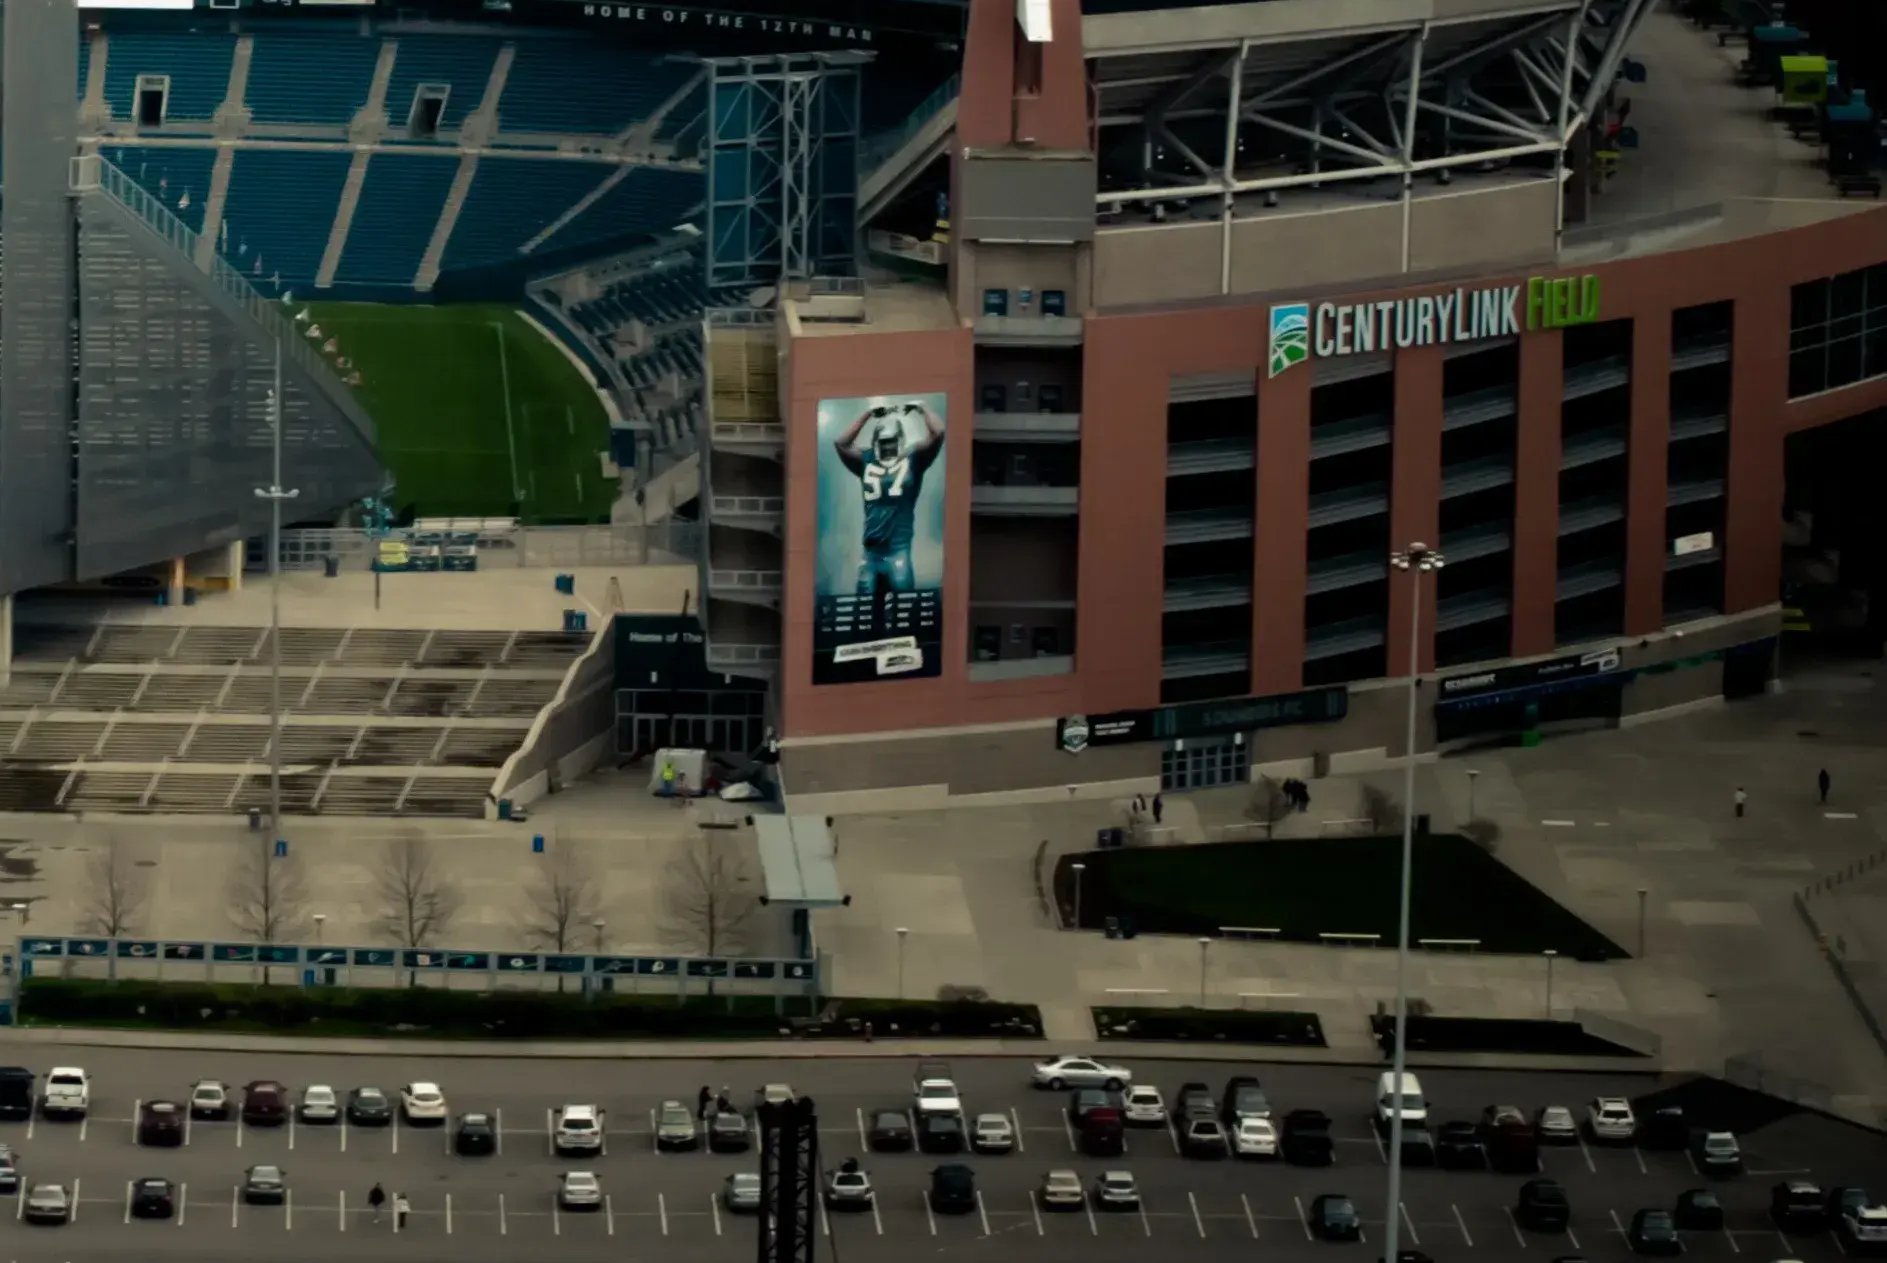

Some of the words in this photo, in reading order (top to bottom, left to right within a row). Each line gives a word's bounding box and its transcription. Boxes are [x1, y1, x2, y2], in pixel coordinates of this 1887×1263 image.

[583, 4, 646, 21] HOME
[662, 9, 688, 24] OF
[704, 12, 744, 29] THE
[760, 19, 813, 36] 12TH
[828, 25, 872, 42] MAN
[1526, 274, 1601, 331] FIELD
[863, 456, 910, 502] 57
